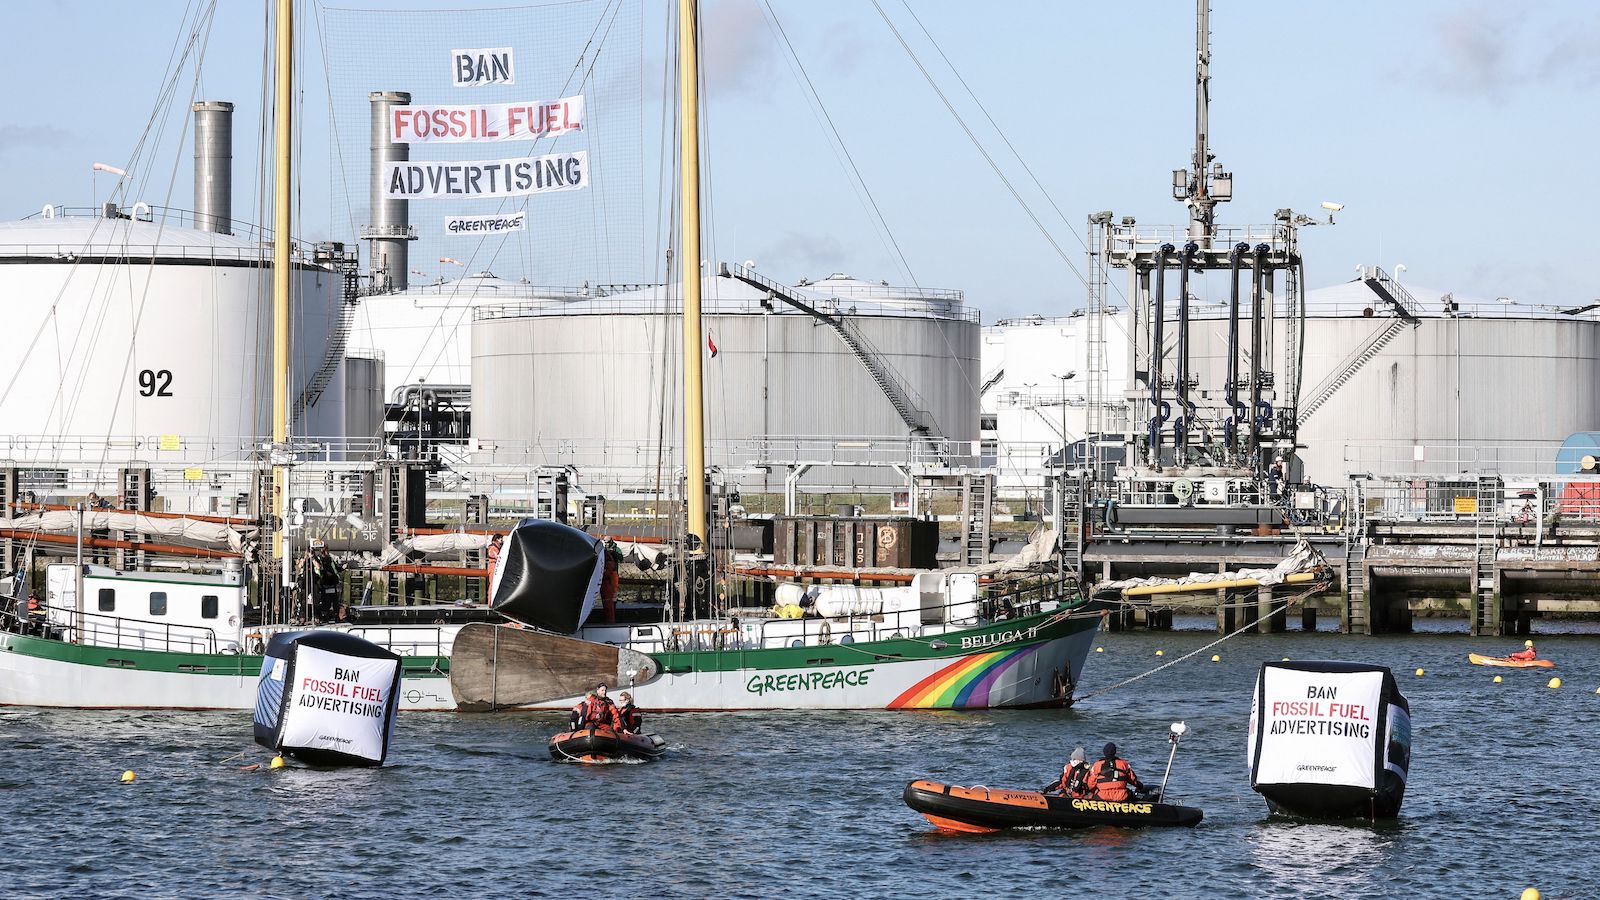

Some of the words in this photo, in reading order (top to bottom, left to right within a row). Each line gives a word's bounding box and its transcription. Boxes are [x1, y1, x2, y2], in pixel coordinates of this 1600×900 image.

[456, 53, 509, 83] BAN
[394, 109, 499, 138] FOSSIL
[507, 102, 580, 136] FUEL
[389, 157, 582, 194] ADVERTISING
[448, 216, 524, 233] GREENPEACE
[138, 369, 173, 397] 92
[1212, 487, 1218, 496] 3
[961, 629, 1023, 649] BELUGA
[1028, 627, 1037, 639] II
[334, 667, 360, 683] BAN
[746, 668, 875, 697] GREENPEACE
[303, 678, 349, 697] FOSSIL
[352, 686, 383, 703] FUEL
[1307, 686, 1337, 699] BAN
[298, 694, 382, 718] ADVERTISING
[1273, 702, 1324, 717] FOSSIL
[1329, 703, 1370, 721] FUEL
[1270, 720, 1370, 739] ADVERTISING
[318, 735, 353, 745] GREENPEACE
[1297, 764, 1338, 772] GREENPEACE
[1072, 798, 1153, 814] GREENPEACE
